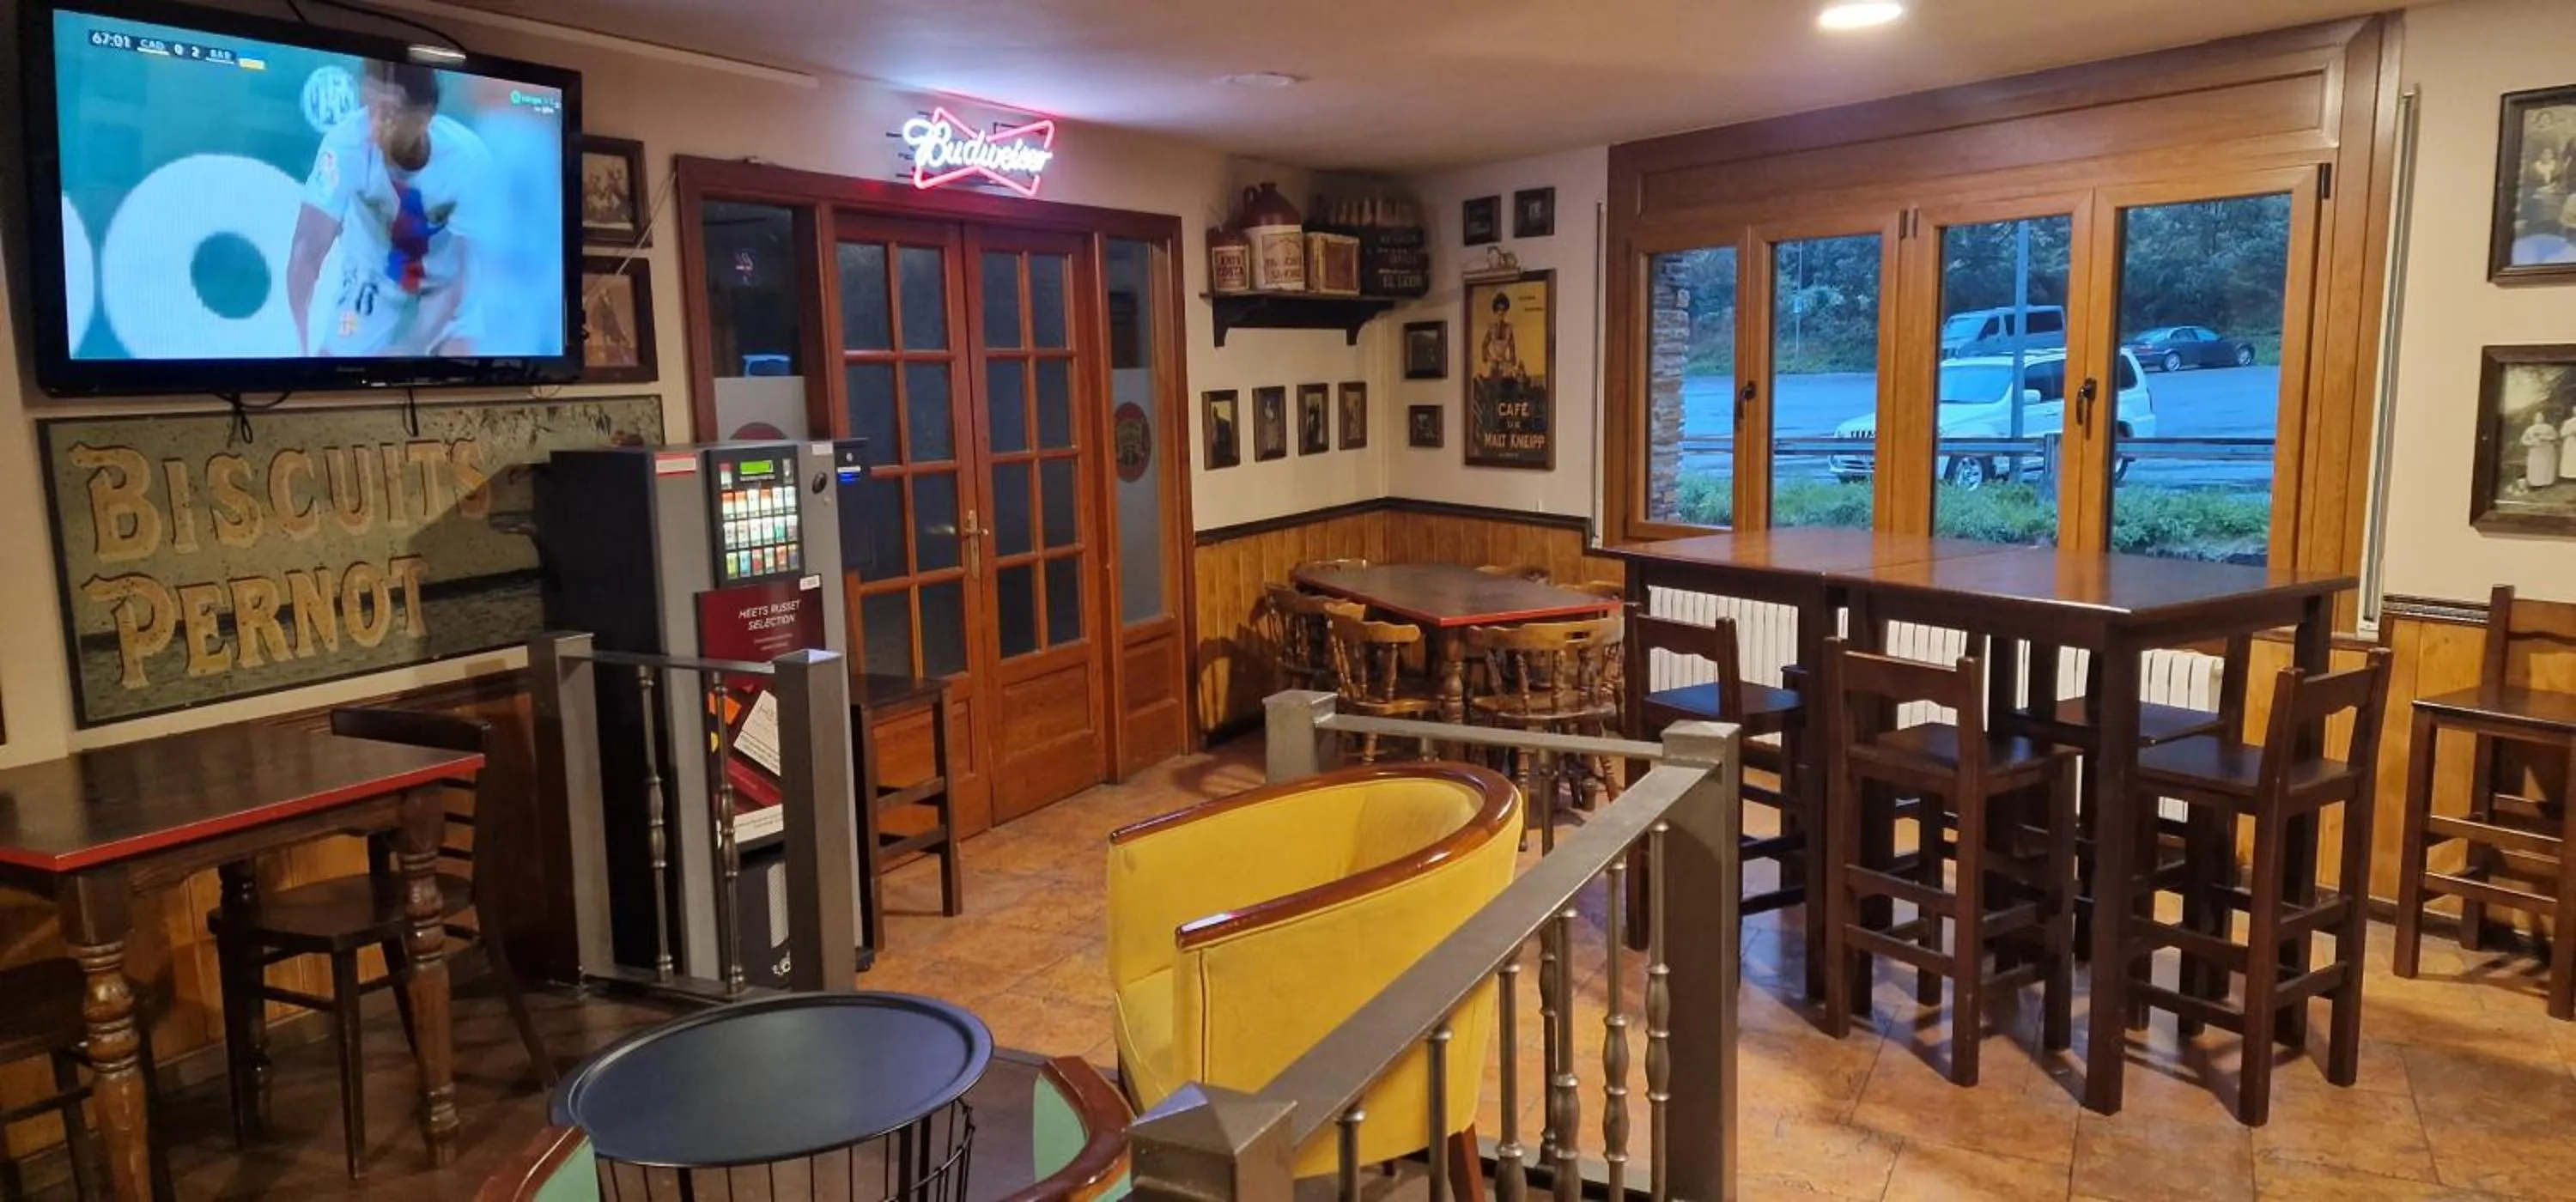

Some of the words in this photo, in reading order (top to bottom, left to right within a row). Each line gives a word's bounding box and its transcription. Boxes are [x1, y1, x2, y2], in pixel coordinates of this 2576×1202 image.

[92, 31, 131, 49] 67:01
[140, 39, 166, 50] CAD
[191, 46, 201, 58] 2
[902, 118, 1054, 172] Budweiser
[67, 436, 492, 562] BISCUITS
[81, 553, 428, 690] PERNOT
[748, 613, 797, 631] SELECTION
